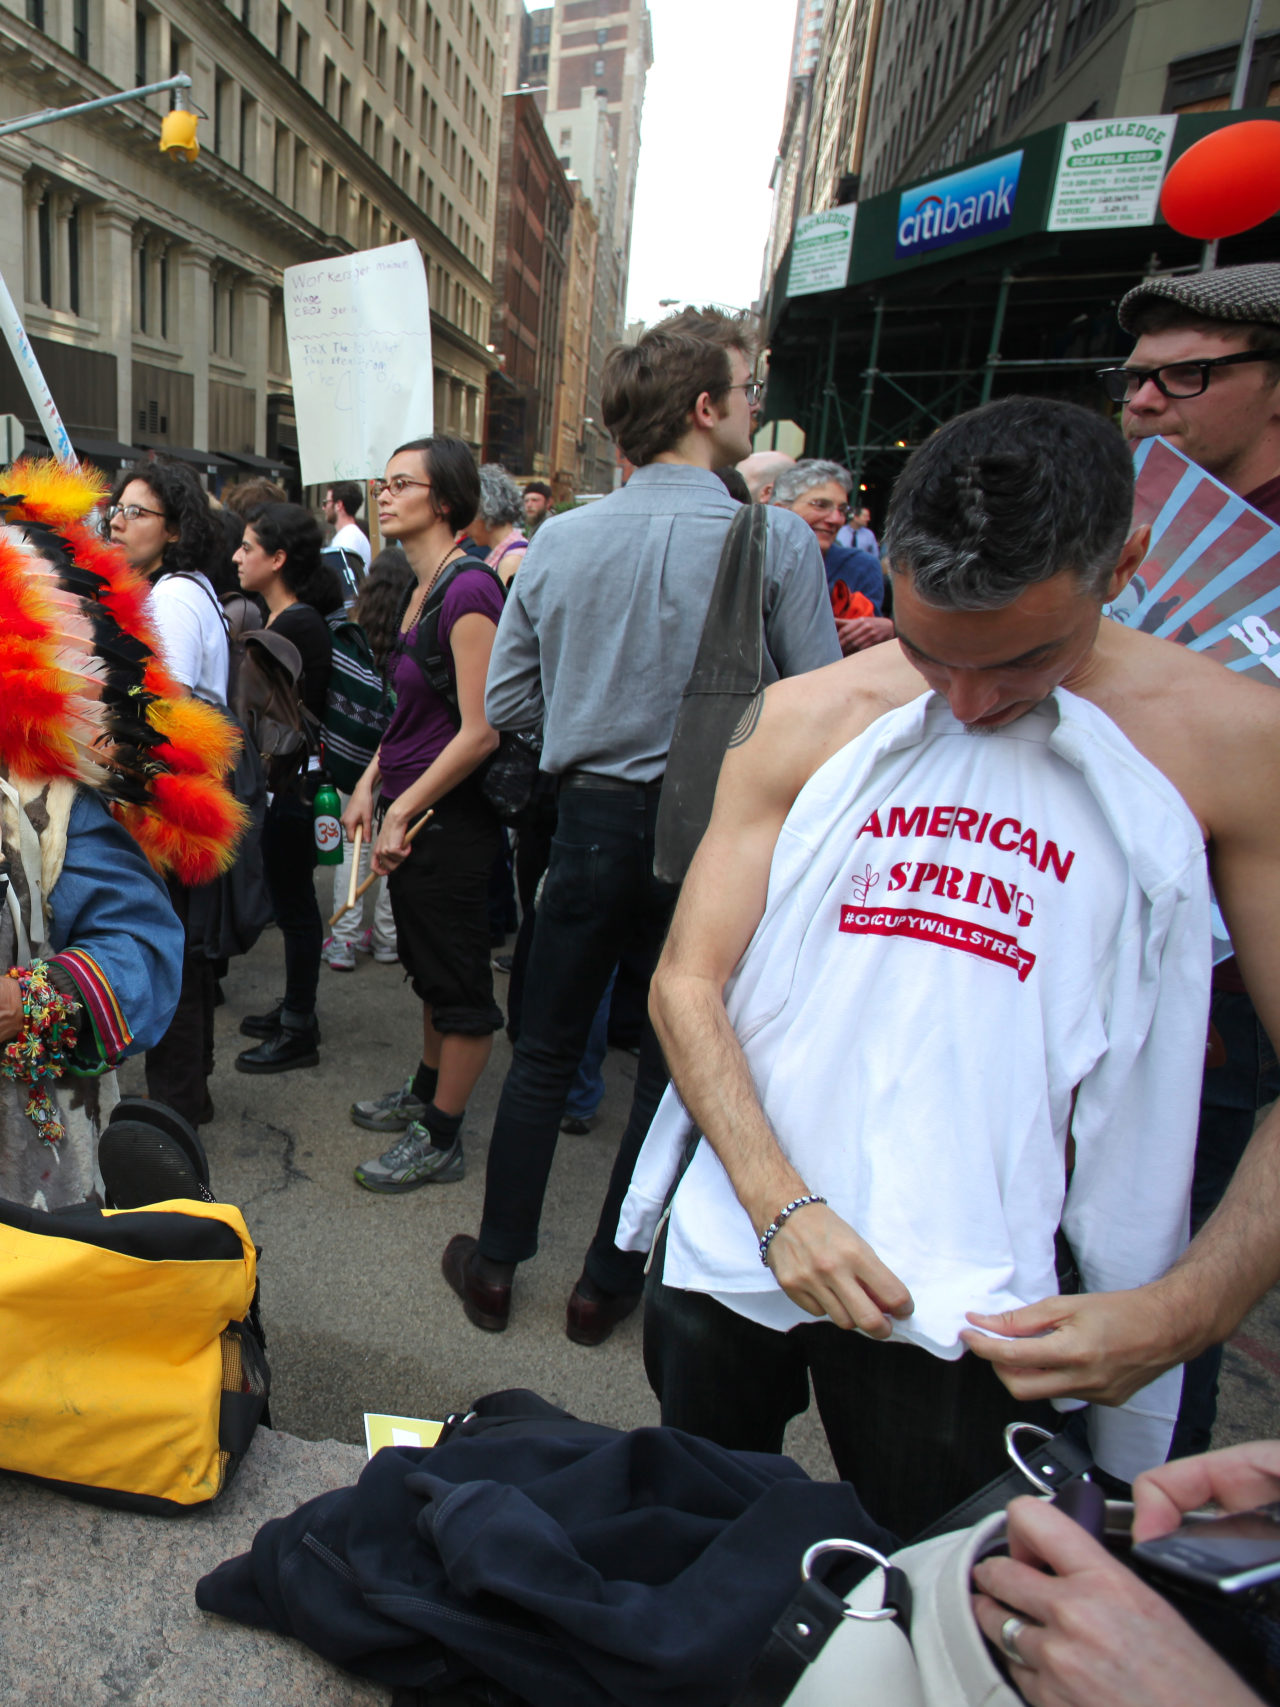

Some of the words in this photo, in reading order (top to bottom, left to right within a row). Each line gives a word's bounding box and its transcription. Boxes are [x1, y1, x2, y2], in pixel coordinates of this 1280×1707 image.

[1071, 122, 1167, 151] ROCKLEDGE
[898, 176, 1015, 247] citibank
[855, 806, 1075, 884] AMERICAN
[887, 861, 1034, 927] SPRING
